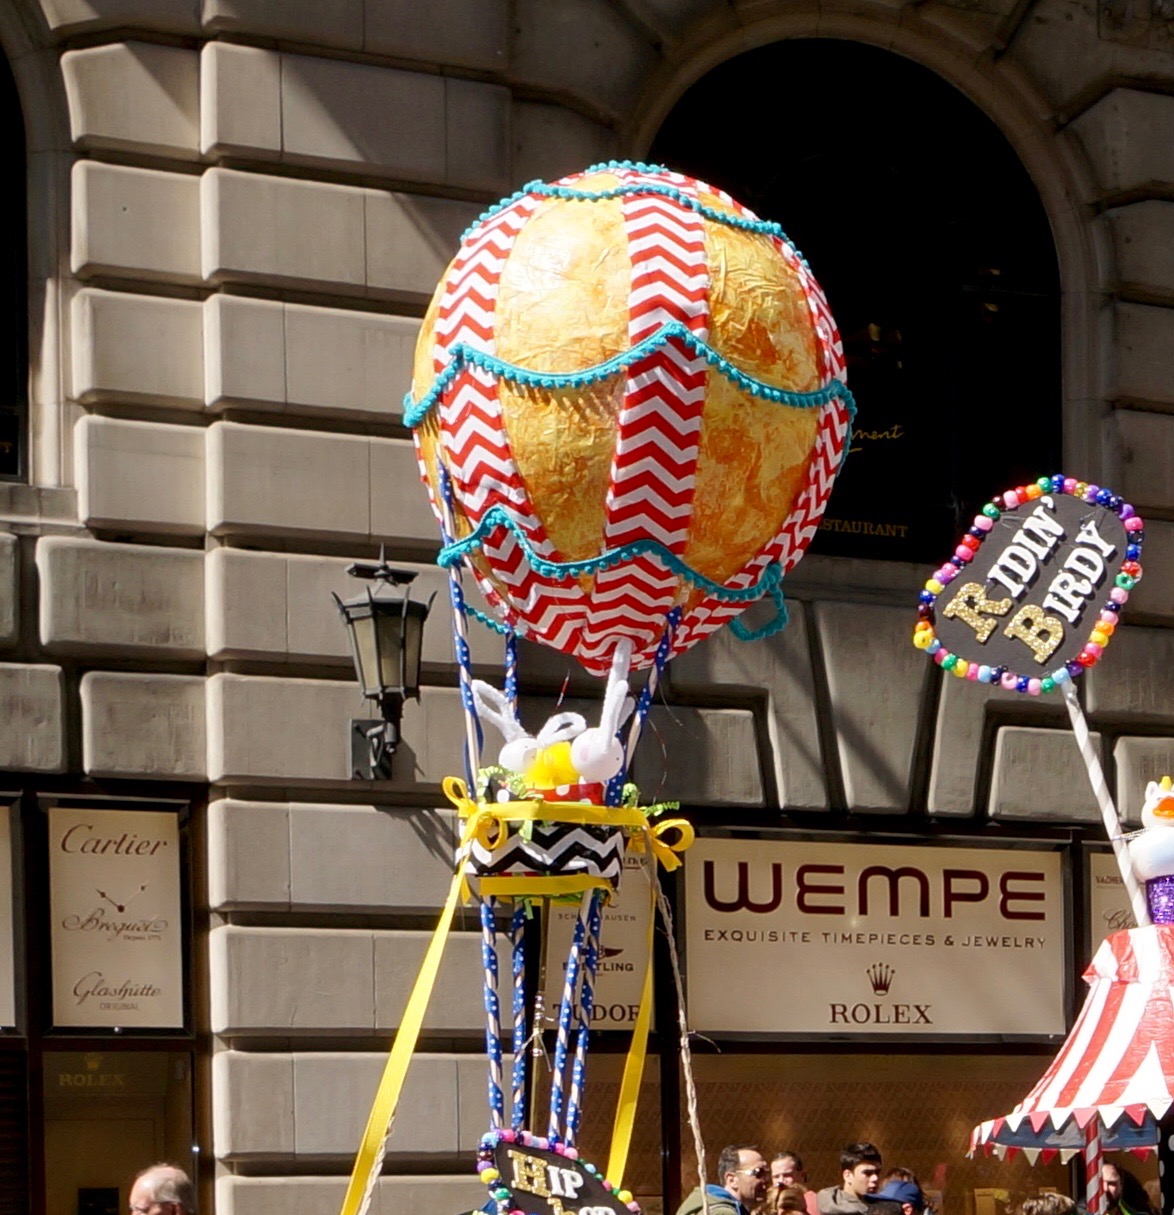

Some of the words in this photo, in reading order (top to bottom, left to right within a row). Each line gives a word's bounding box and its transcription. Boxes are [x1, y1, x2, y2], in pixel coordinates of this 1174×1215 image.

[821, 517, 909, 538] STAURANT
[1004, 520, 1116, 664] BIRDY
[61, 823, 168, 855] Cartier
[704, 860, 1046, 921] WEMPE
[704, 929, 811, 943] EXQUISITE
[822, 932, 936, 946] TIMEPIECES
[944, 935, 955, 946] &
[962, 936, 1046, 949] JEWELRY
[829, 1003, 934, 1024] ROLEX
[59, 1073, 126, 1087] ROLEX
[507, 1149, 584, 1200] HIP
